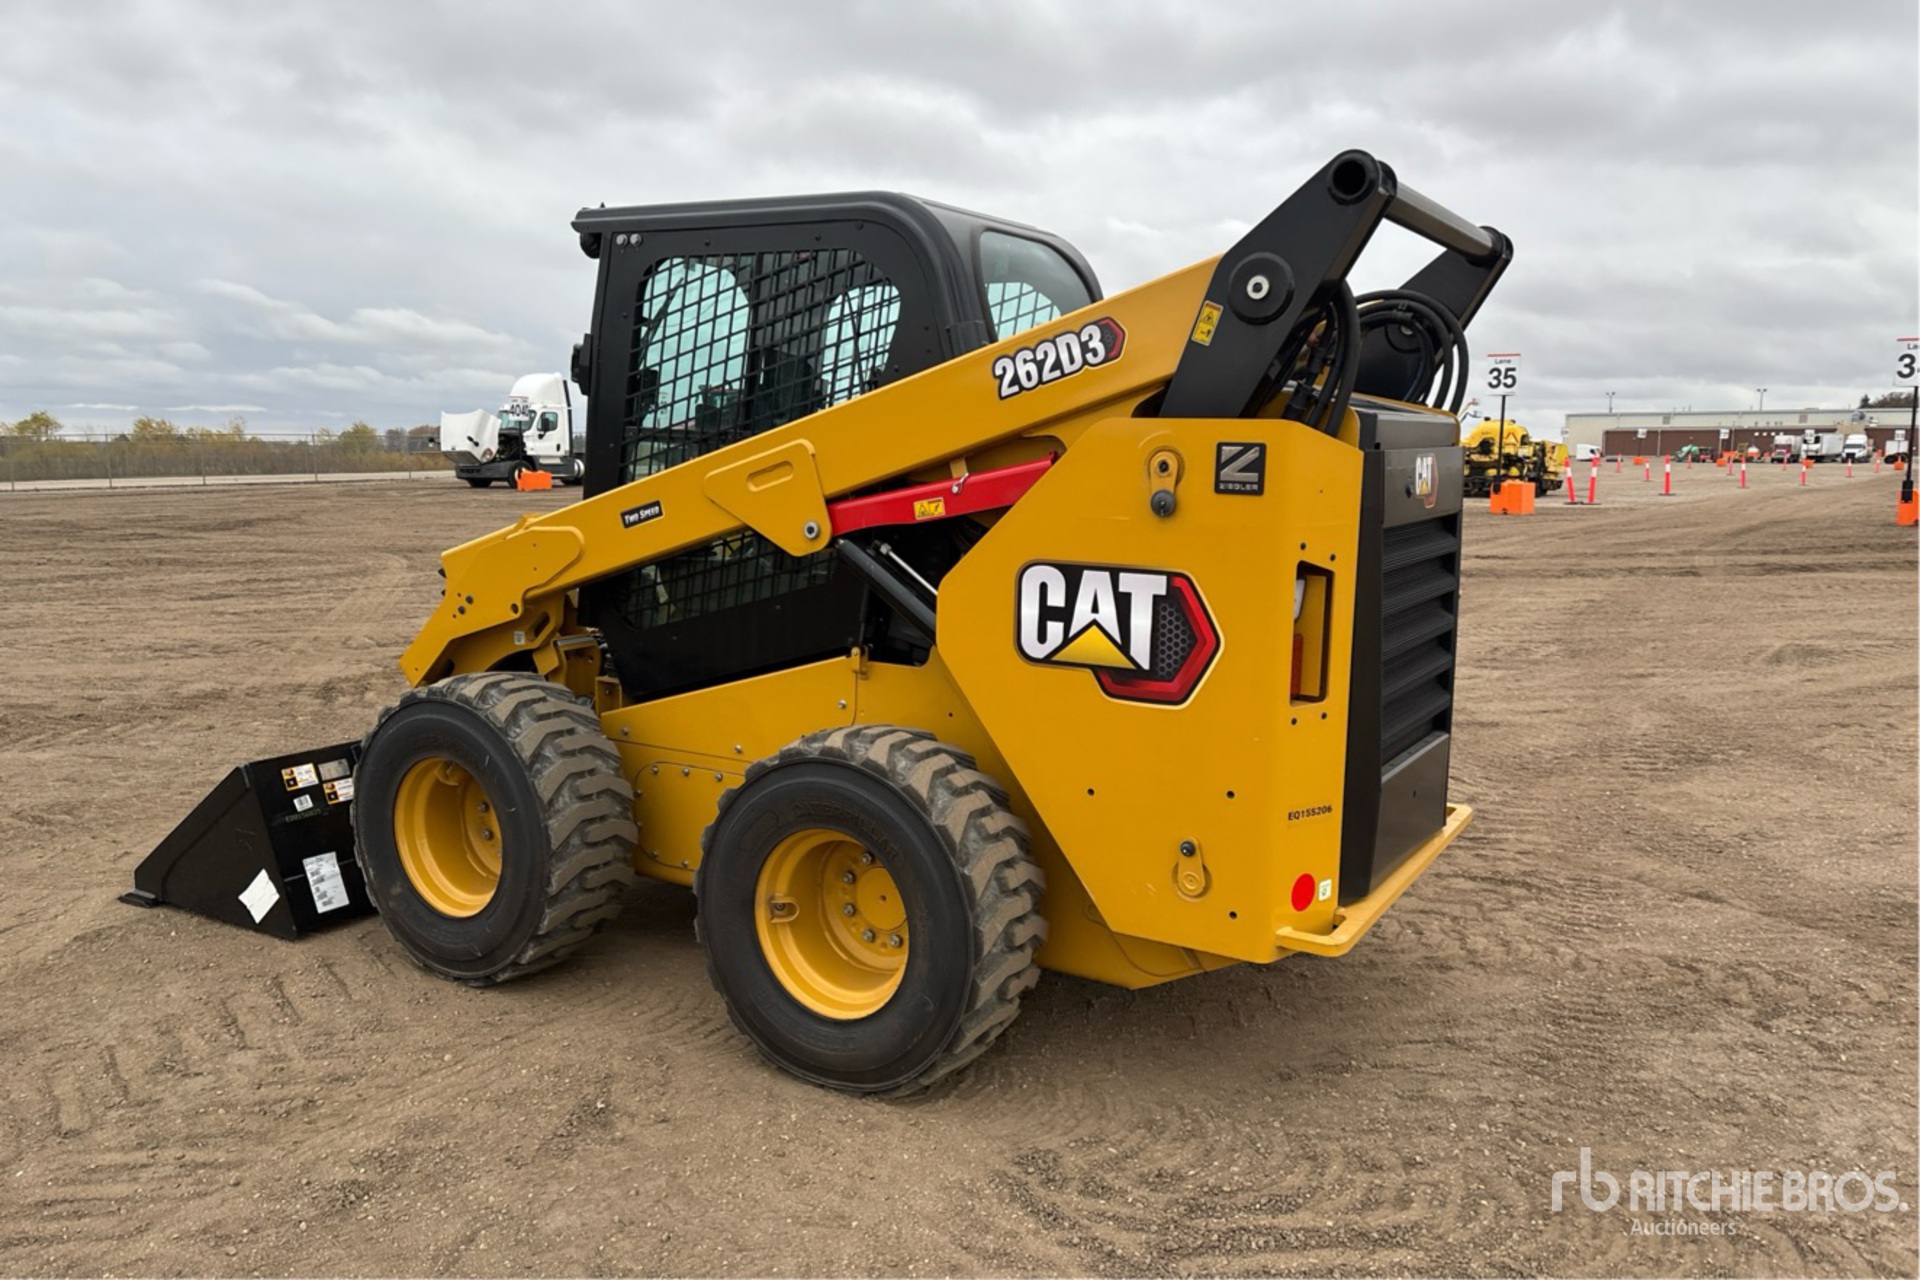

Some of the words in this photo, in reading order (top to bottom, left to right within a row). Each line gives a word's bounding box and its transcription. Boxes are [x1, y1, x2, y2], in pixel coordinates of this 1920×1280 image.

[993, 324, 1106, 399] 262D3
[1488, 366, 1517, 389] 35
[1897, 353, 1919, 379] 3
[1020, 564, 1168, 671] CAT
